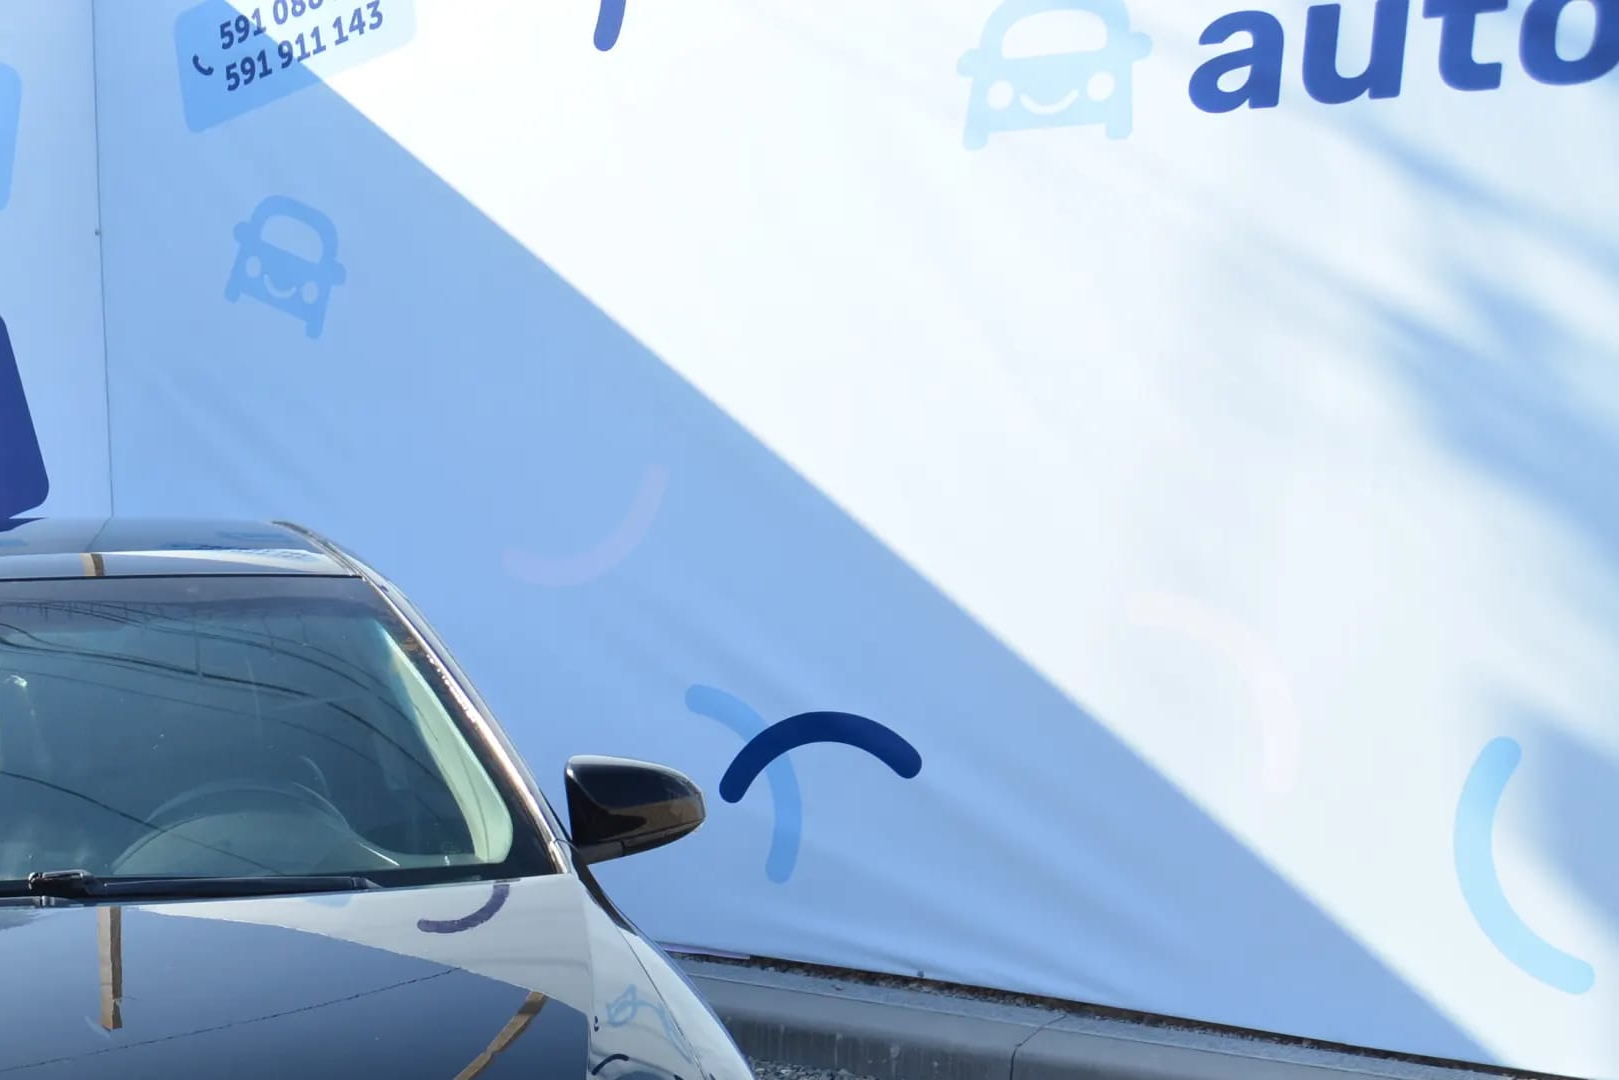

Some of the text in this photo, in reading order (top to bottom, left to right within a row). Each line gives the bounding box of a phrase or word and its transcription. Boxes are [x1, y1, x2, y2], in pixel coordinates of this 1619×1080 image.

[219, 8, 267, 50] 591
[225, 0, 384, 92] 591 911 143
[1188, 0, 1619, 114] auto
